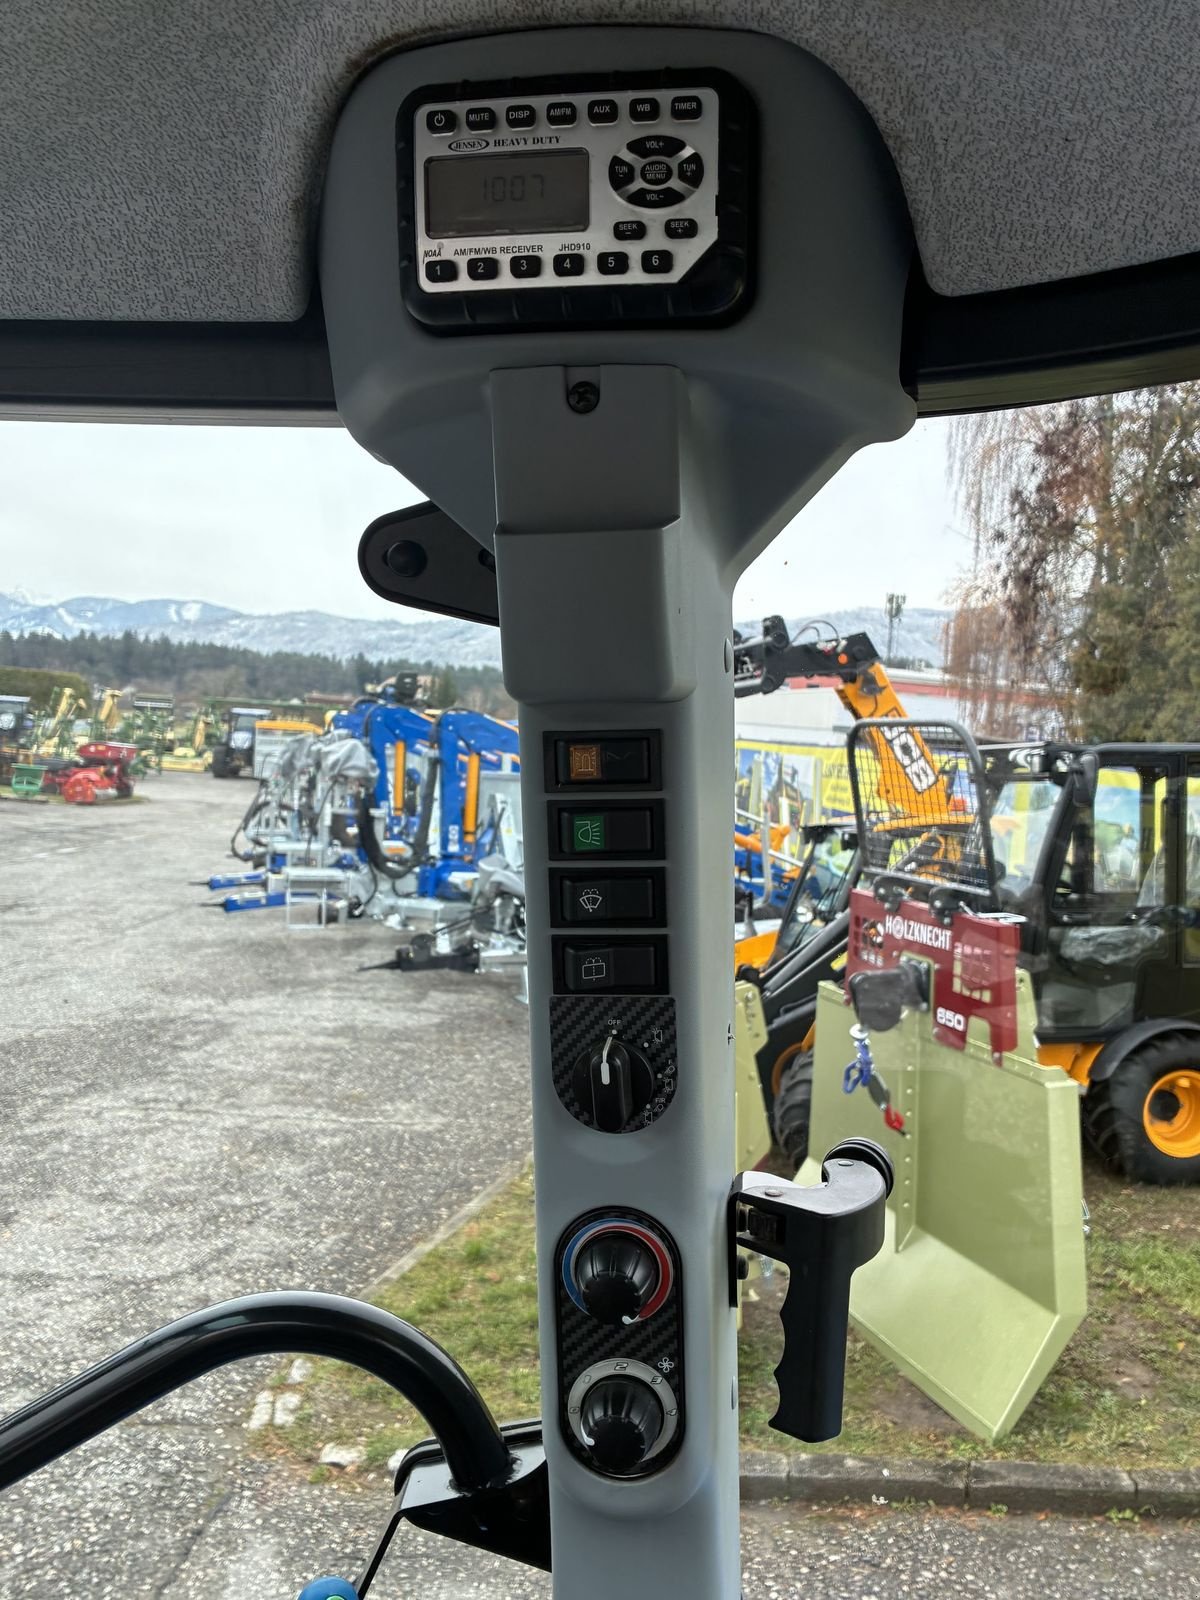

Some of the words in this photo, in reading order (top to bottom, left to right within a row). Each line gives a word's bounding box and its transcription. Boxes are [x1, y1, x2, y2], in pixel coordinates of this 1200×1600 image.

[593, 106, 610, 114] AUX
[636, 104, 650, 112] WB
[674, 102, 696, 110] TIMER
[509, 110, 530, 119] DISP
[550, 108, 572, 116] AM/FM
[468, 113, 490, 122] MUTE
[453, 141, 483, 150] JENSEN
[493, 138, 528, 147] HEAVY
[532, 136, 561, 144] DUTY
[683, 163, 696, 171] TUN
[618, 222, 638, 231] SEEK
[454, 246, 498, 256] AM/FM/WB
[500, 245, 544, 254] RECEIVER
[558, 243, 591, 252] JHD910
[563, 258, 571, 268] 4
[608, 257, 615, 267] 5
[652, 255, 659, 265] 6
[477, 262, 484, 272] 2
[520, 260, 527, 270] 3
[435, 265, 441, 276] 1
[885, 915, 952, 951] HOLZKNECHT
[614, 1362, 628, 1371] 2
